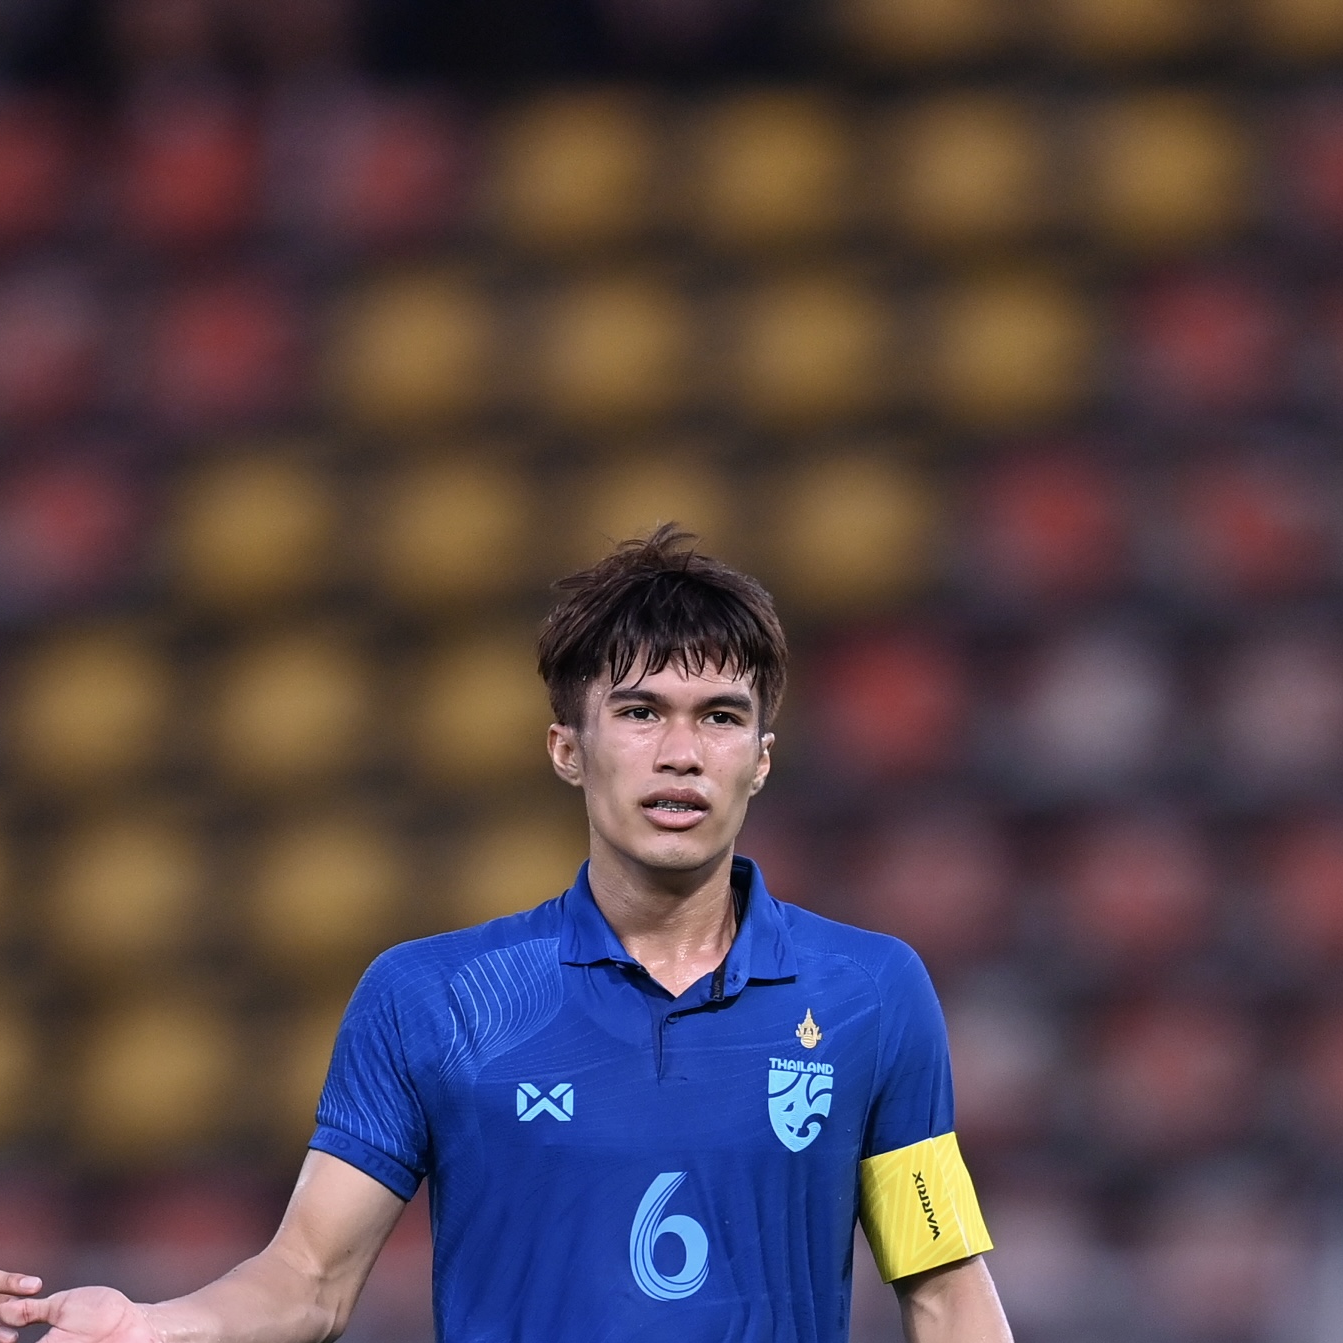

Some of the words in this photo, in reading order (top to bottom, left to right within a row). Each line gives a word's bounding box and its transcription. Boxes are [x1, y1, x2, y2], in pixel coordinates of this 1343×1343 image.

[768, 1057, 835, 1075] THAILAND
[630, 1172, 709, 1301] 6
[912, 1171, 940, 1241] WARRIX
